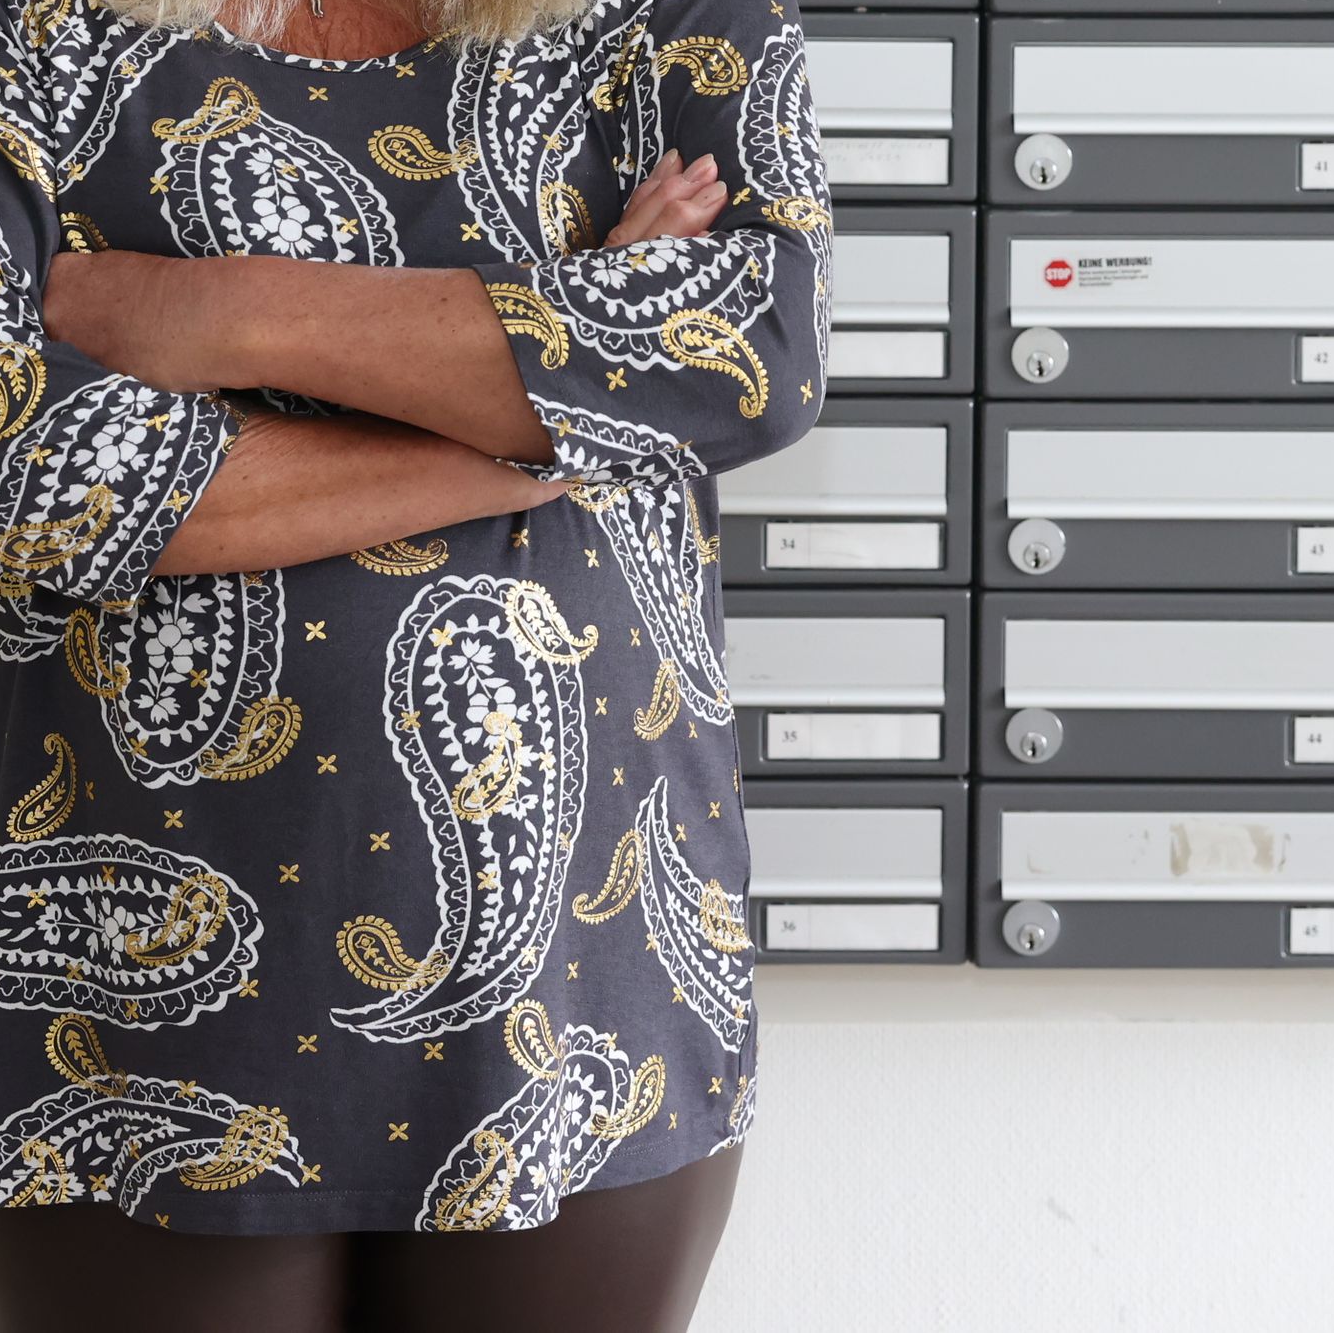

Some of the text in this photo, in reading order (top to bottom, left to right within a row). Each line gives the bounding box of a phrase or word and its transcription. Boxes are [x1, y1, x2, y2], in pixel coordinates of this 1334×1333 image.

[1314, 161, 1328, 172] 41
[1078, 256, 1153, 268] KEINE WERBUNG!
[1046, 267, 1072, 281] STOP
[1314, 352, 1328, 364] 42
[782, 538, 796, 550] 34
[1311, 544, 1325, 555] 43
[783, 730, 798, 742] 35
[1307, 733, 1323, 744] 44
[781, 920, 797, 932] 36
